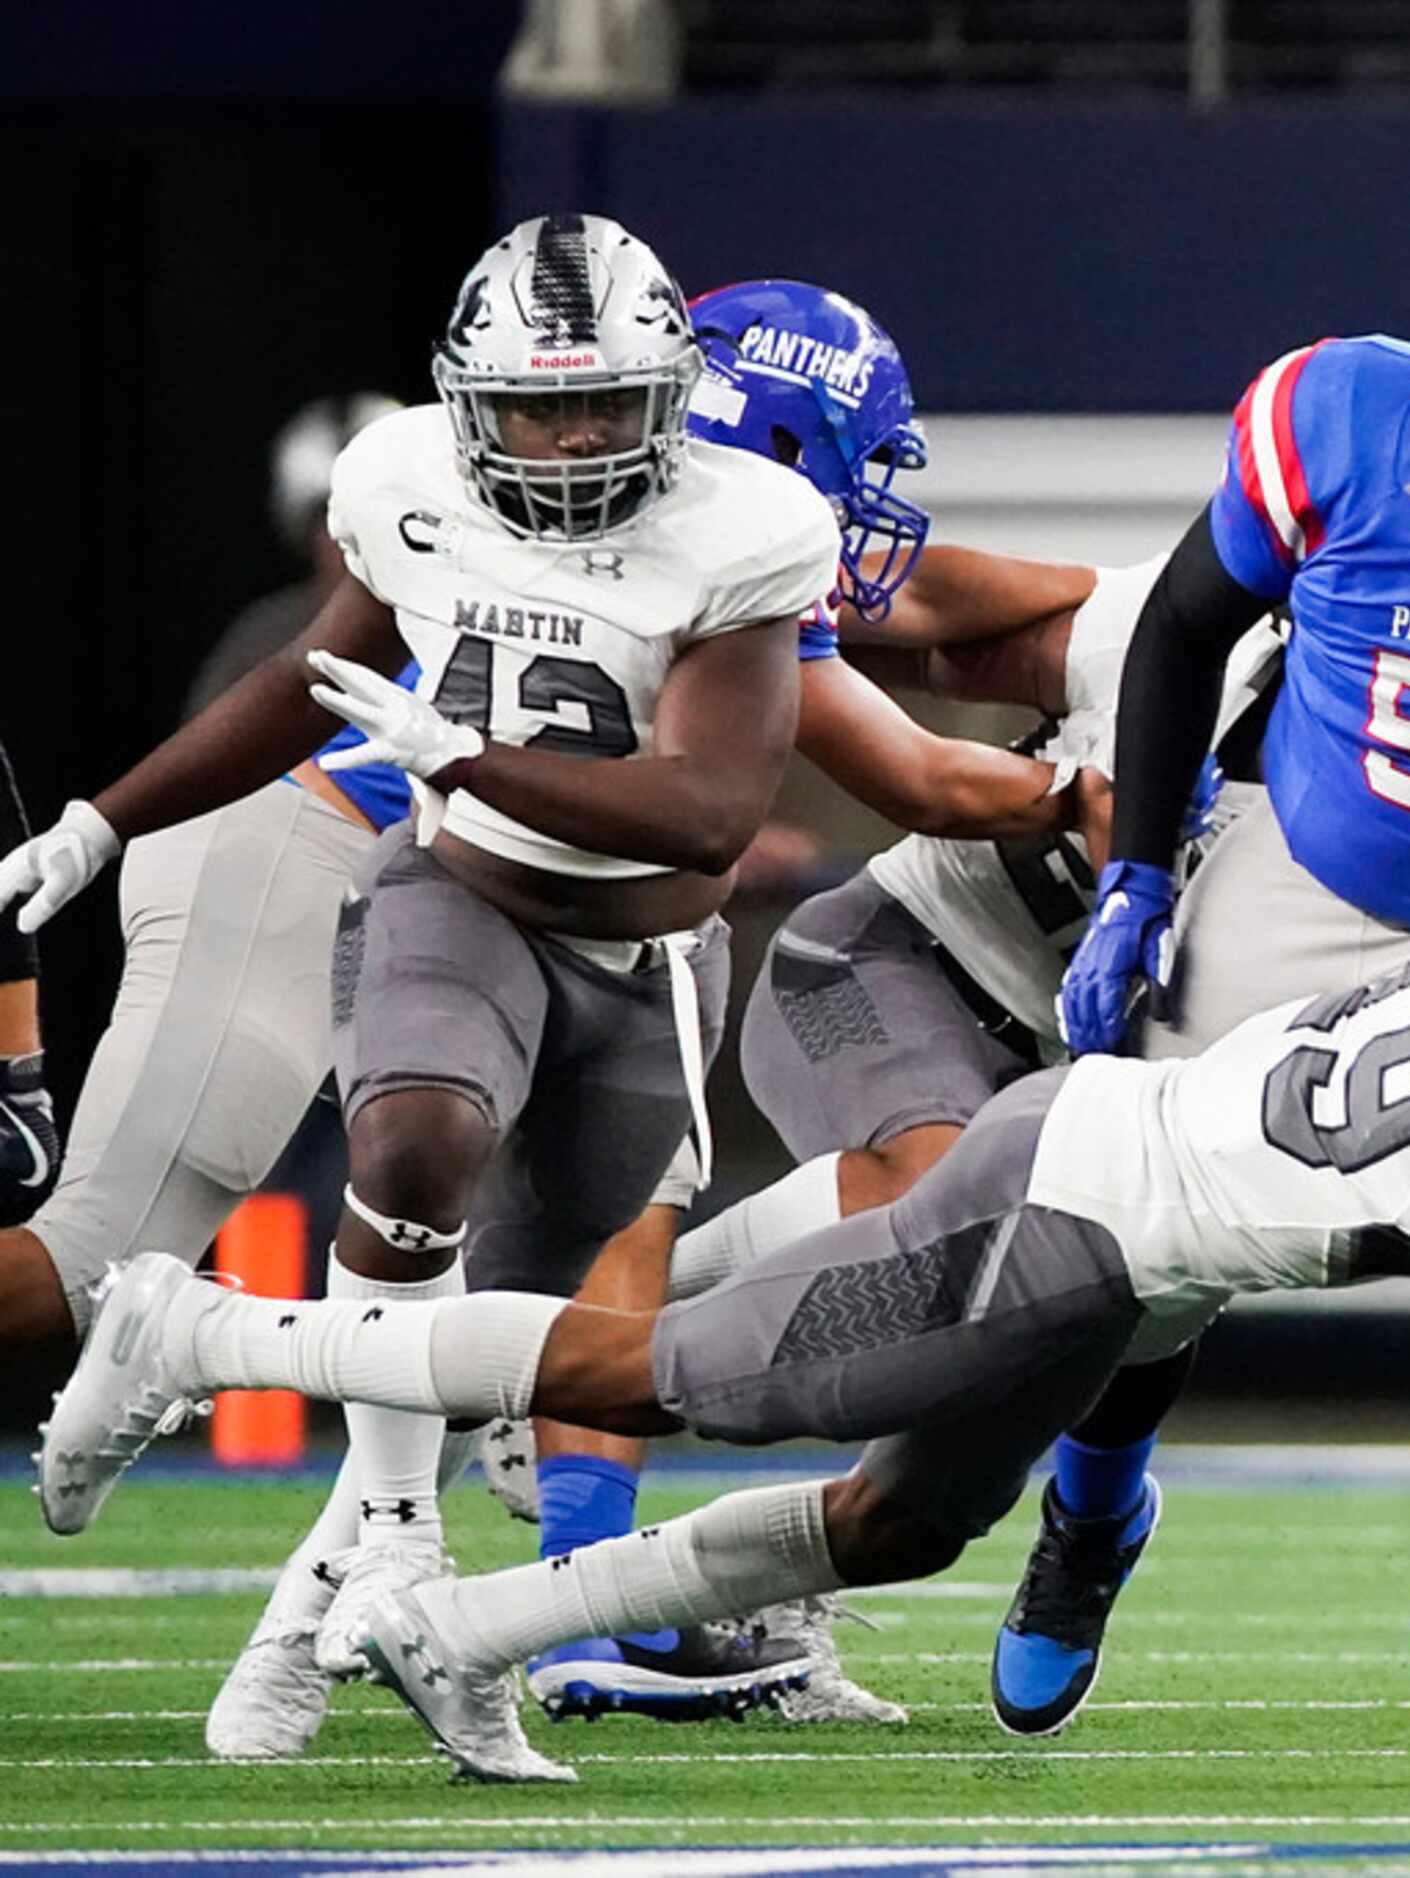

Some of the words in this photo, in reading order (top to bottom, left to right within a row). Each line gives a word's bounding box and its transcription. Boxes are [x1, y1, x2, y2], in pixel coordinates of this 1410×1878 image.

[530, 353, 596, 369] Riddell
[739, 324, 874, 398] PANTHERS
[454, 599, 584, 646] MARTIN
